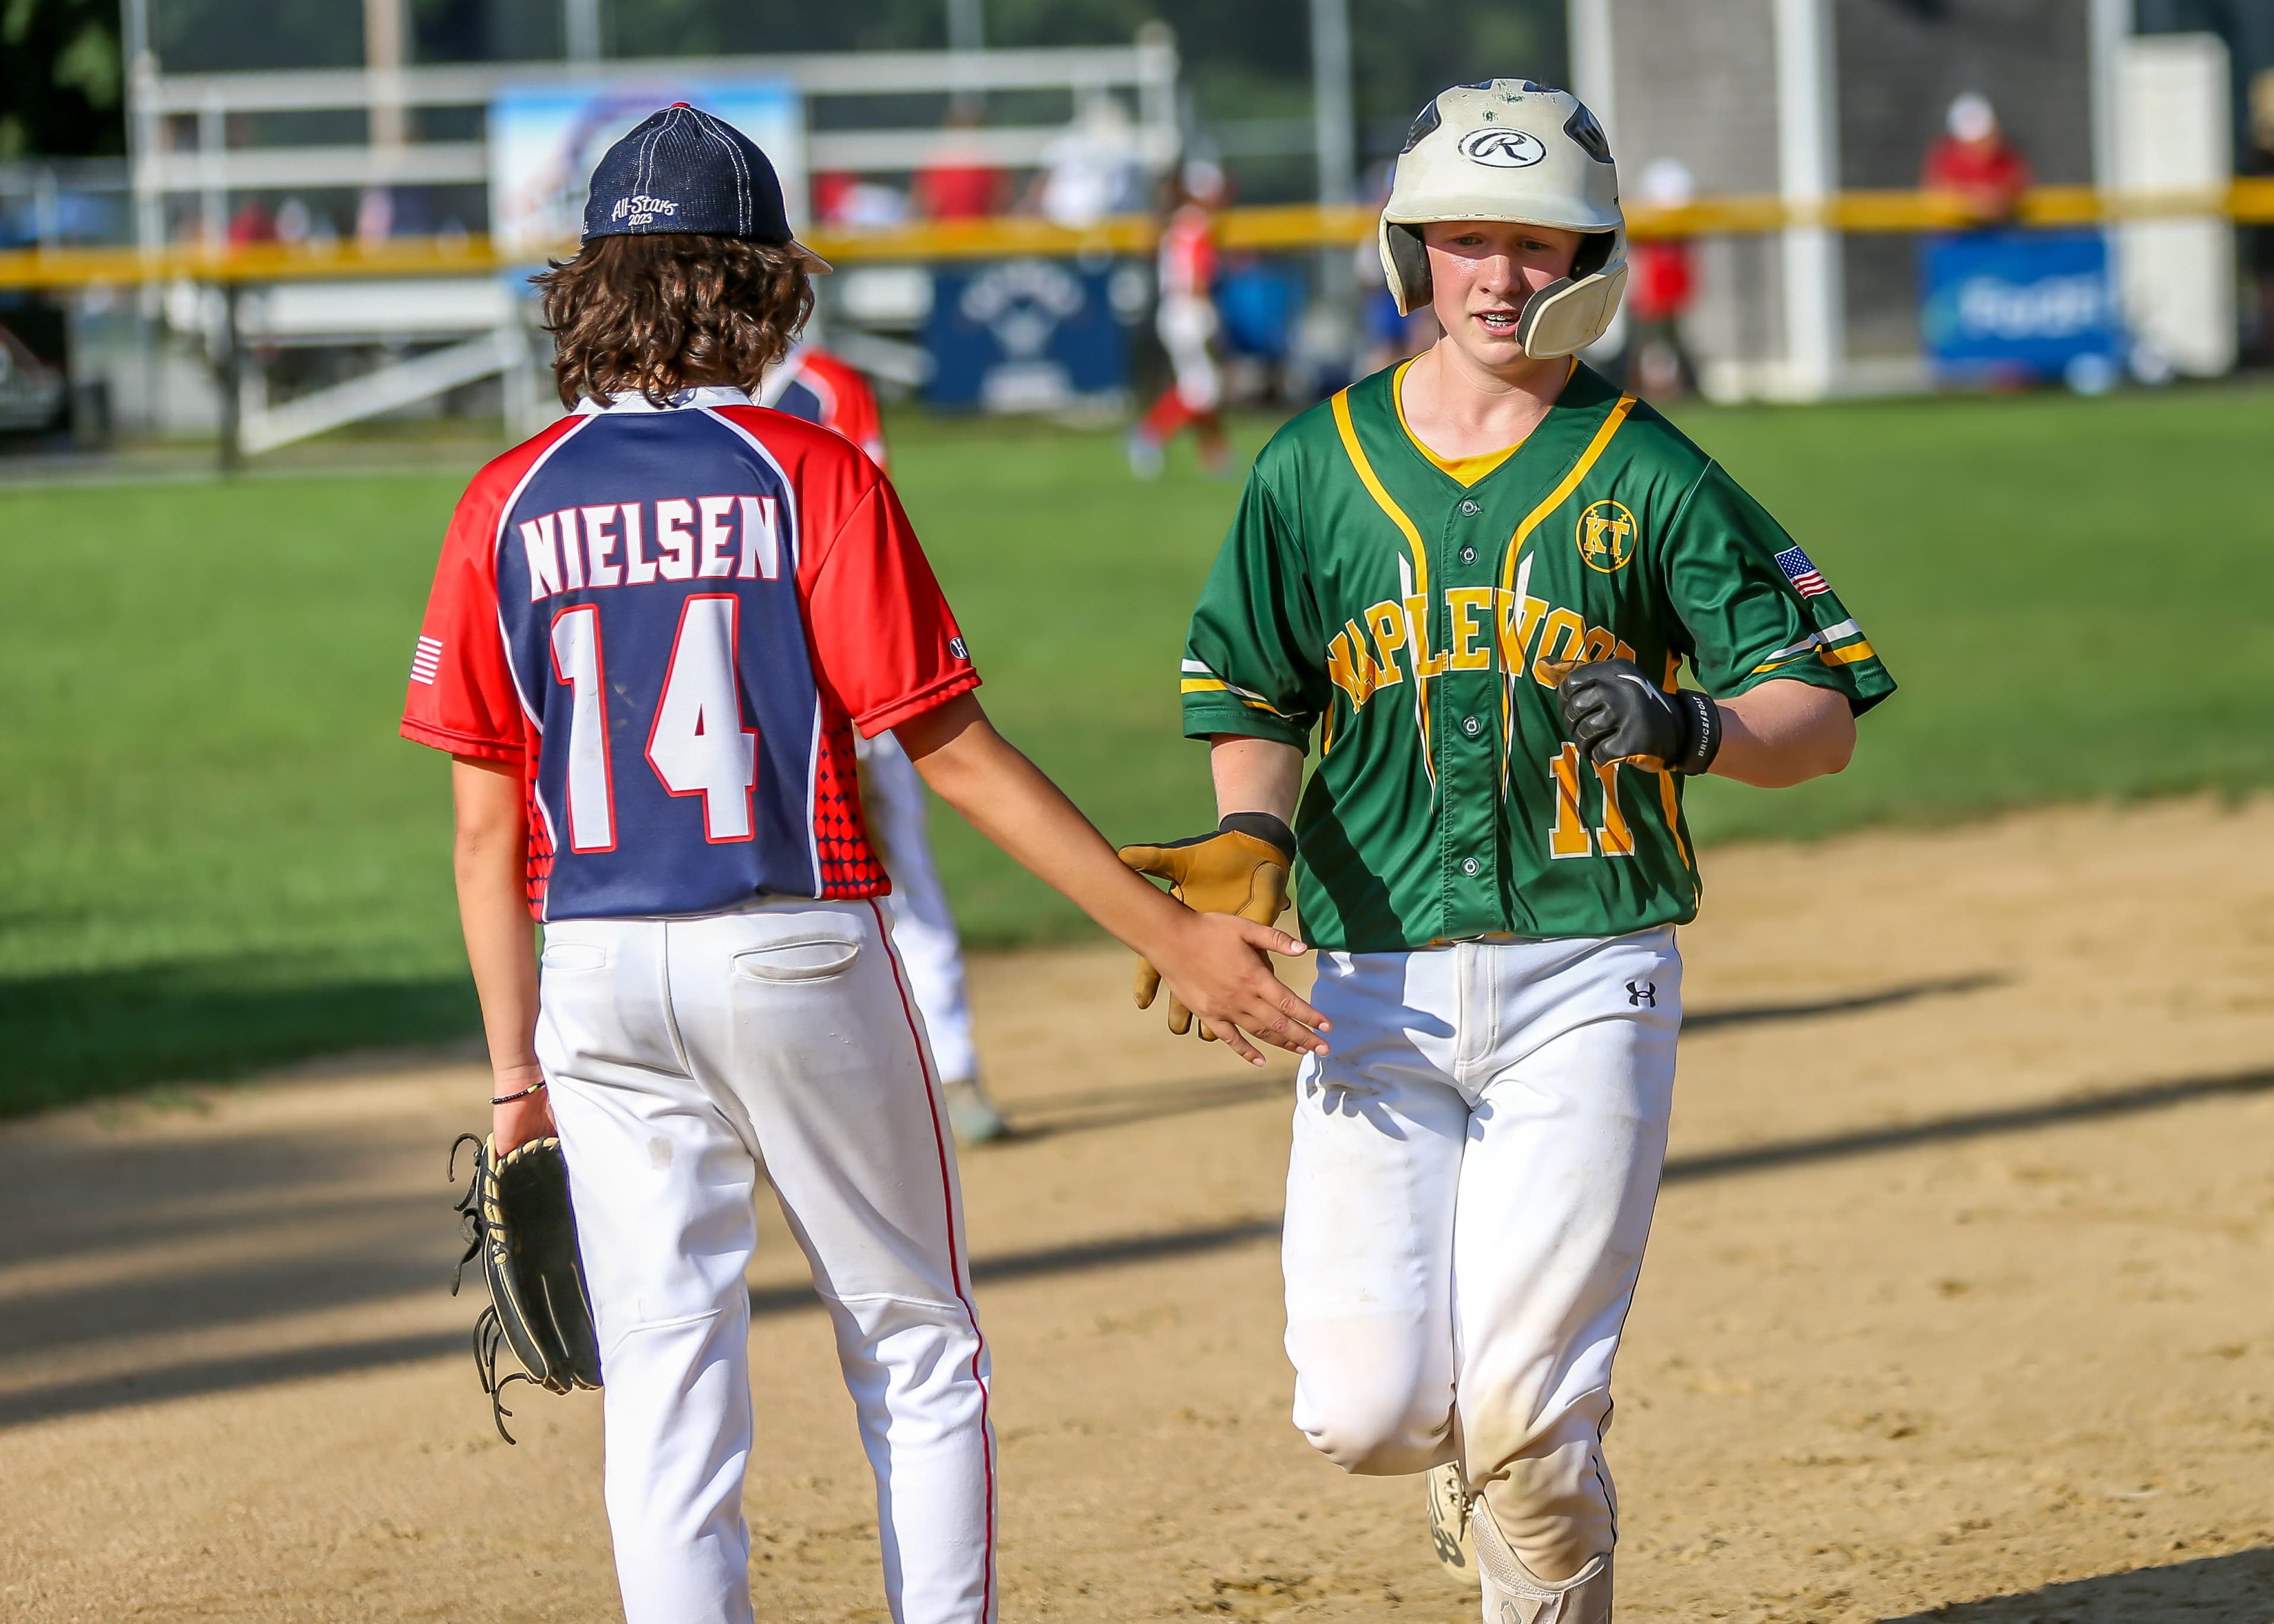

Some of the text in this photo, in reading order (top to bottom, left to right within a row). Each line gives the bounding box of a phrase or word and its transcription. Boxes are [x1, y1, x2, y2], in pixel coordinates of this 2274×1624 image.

[611, 195, 679, 222] All-Stars
[628, 213, 653, 226] 2023
[519, 494, 779, 603] NIELSEN
[1584, 516, 1630, 555] KT
[1327, 587, 1636, 715] MAPLEWO
[551, 593, 759, 854] 14
[1549, 741, 1636, 860] 11
